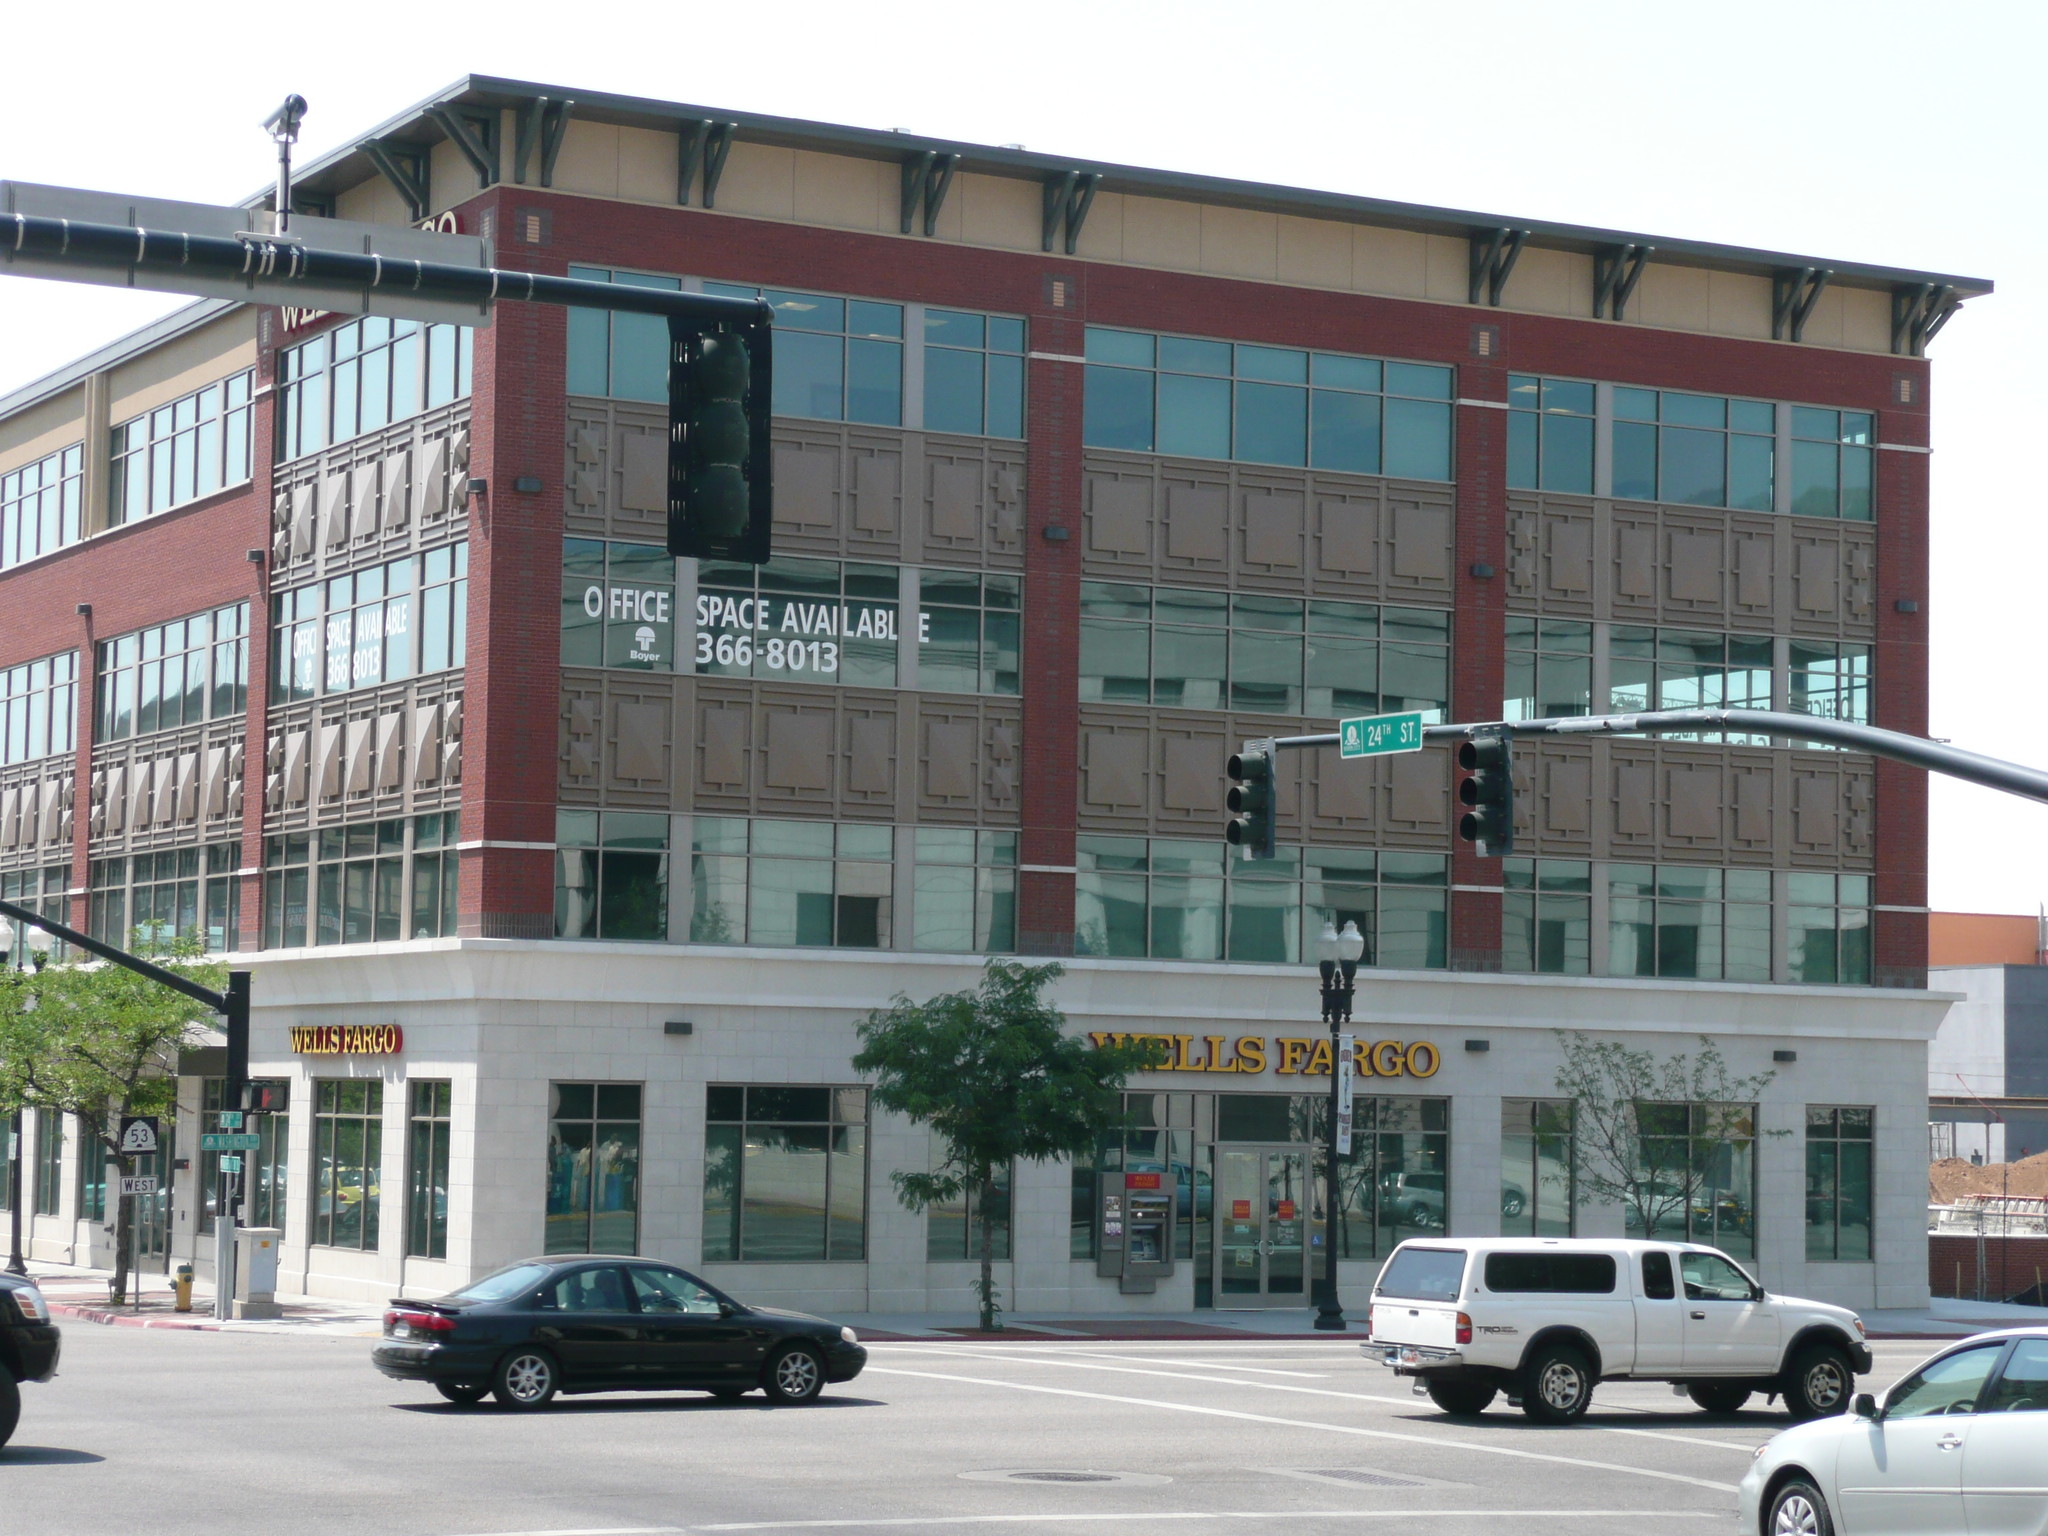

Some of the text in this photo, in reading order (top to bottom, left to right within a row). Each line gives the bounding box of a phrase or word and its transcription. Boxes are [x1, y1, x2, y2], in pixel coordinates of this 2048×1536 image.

[584, 585, 930, 644] OFFICE SPACE AVAILABLE
[630, 650, 661, 662] Boyer
[695, 632, 838, 673] 366-8013
[1367, 721, 1417, 747] 24TH ST.
[288, 1024, 397, 1054] WELLS FARGO
[1277, 1037, 1441, 1079] FARGO
[131, 1128, 148, 1143] 53
[124, 1179, 154, 1192] WEST
